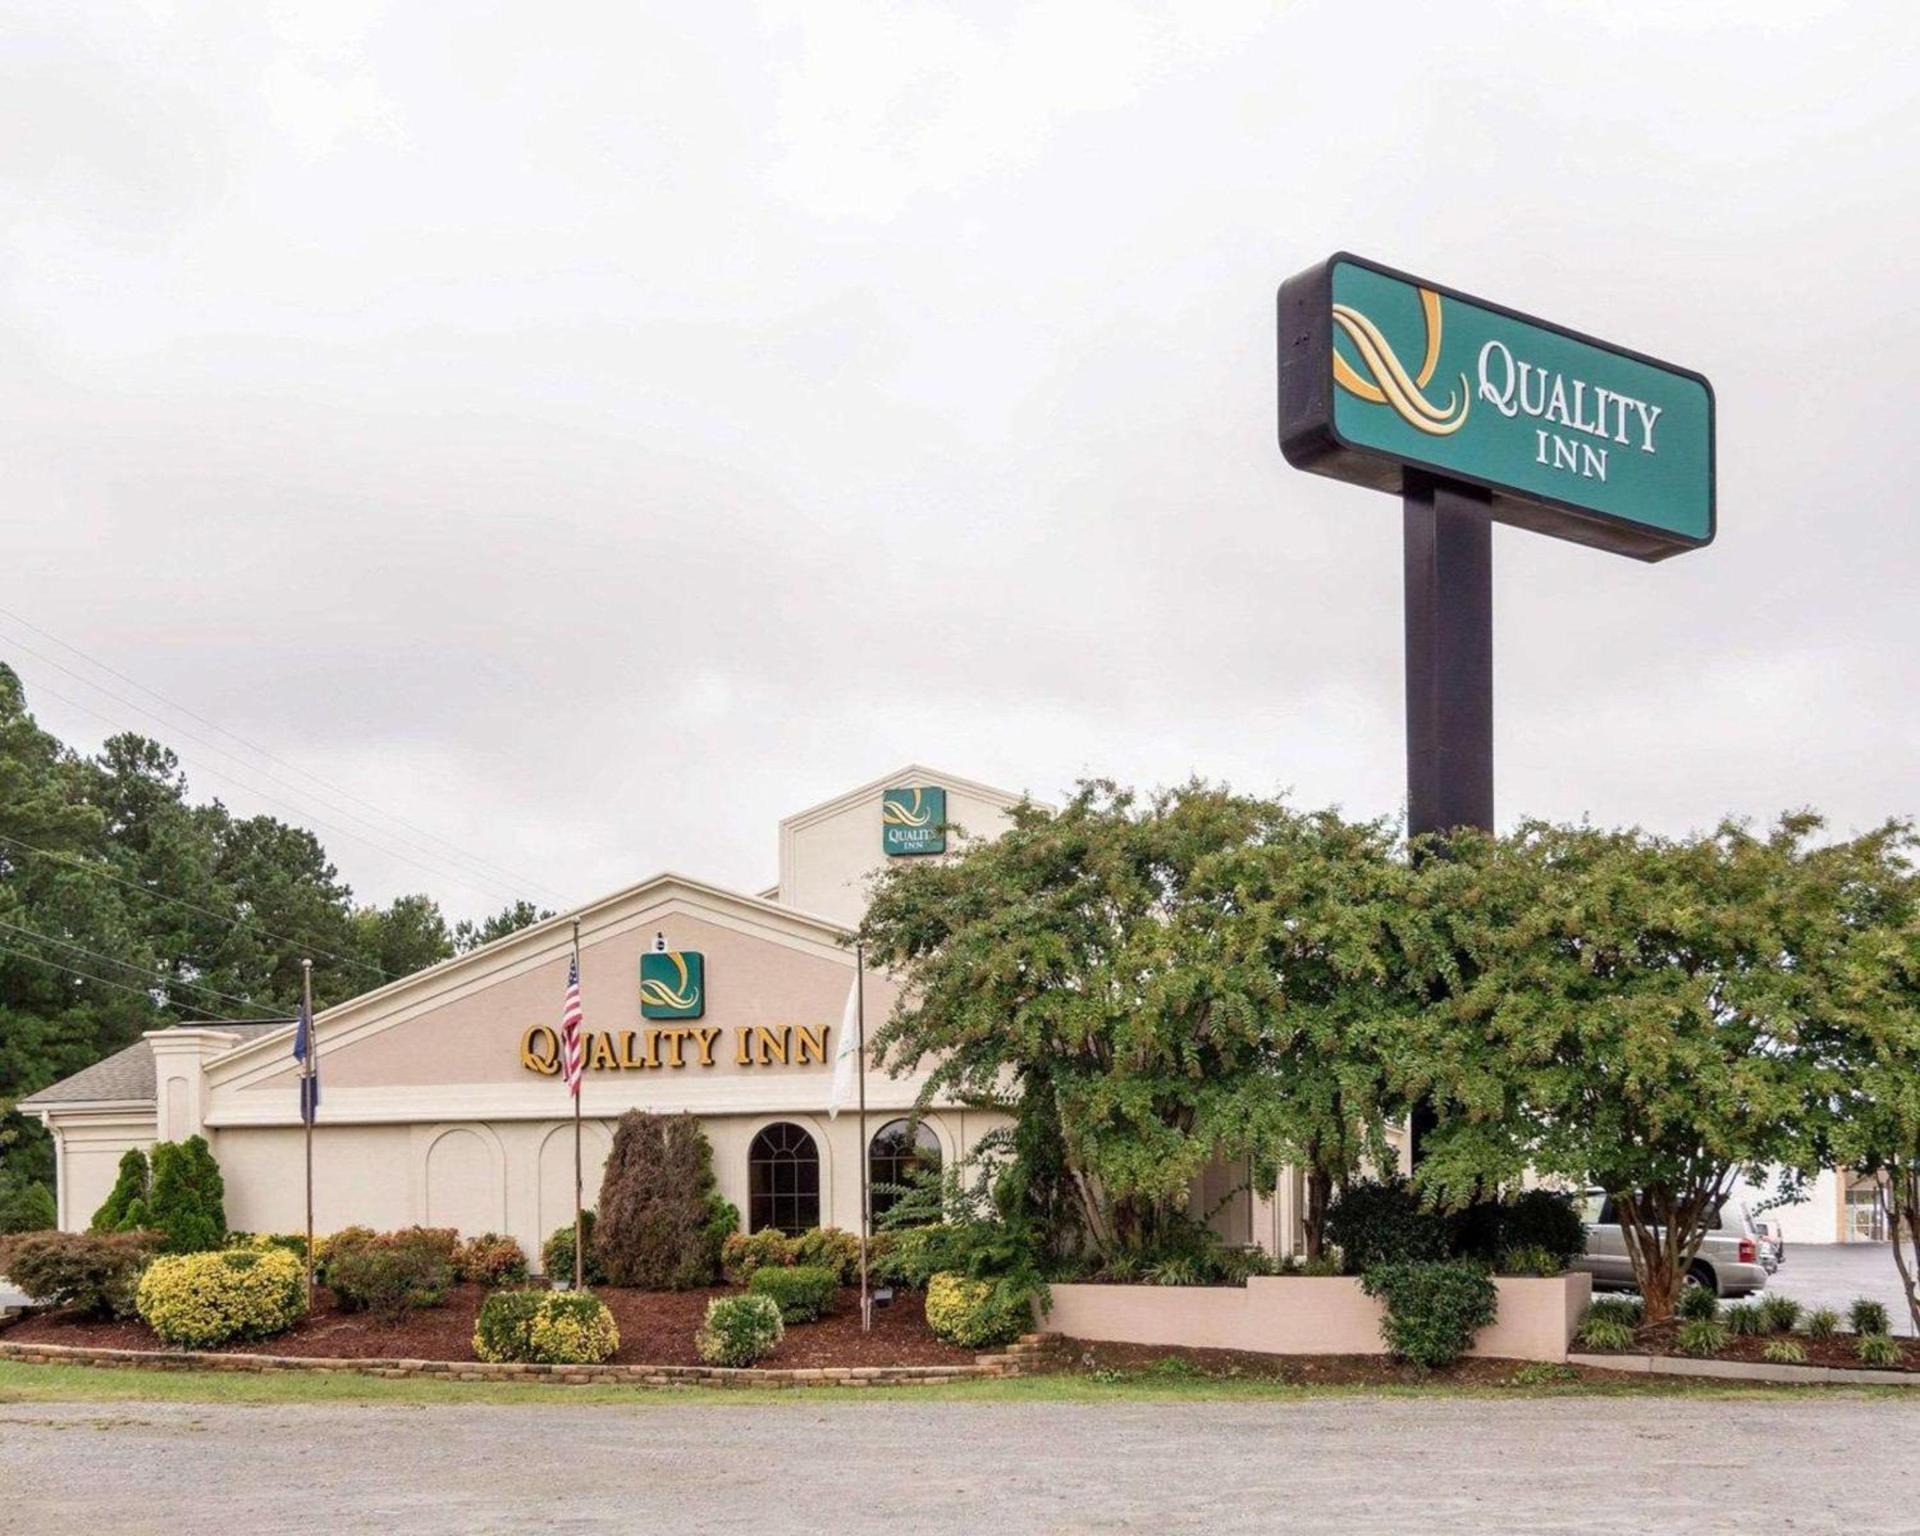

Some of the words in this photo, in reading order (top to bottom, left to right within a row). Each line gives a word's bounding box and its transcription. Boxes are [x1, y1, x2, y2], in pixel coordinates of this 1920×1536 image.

[1478, 340, 1662, 453] QUALITY
[1535, 429, 1608, 482] INN
[888, 828, 935, 844] QUALIT
[903, 841, 924, 850] INN
[734, 1024, 830, 1066] INN
